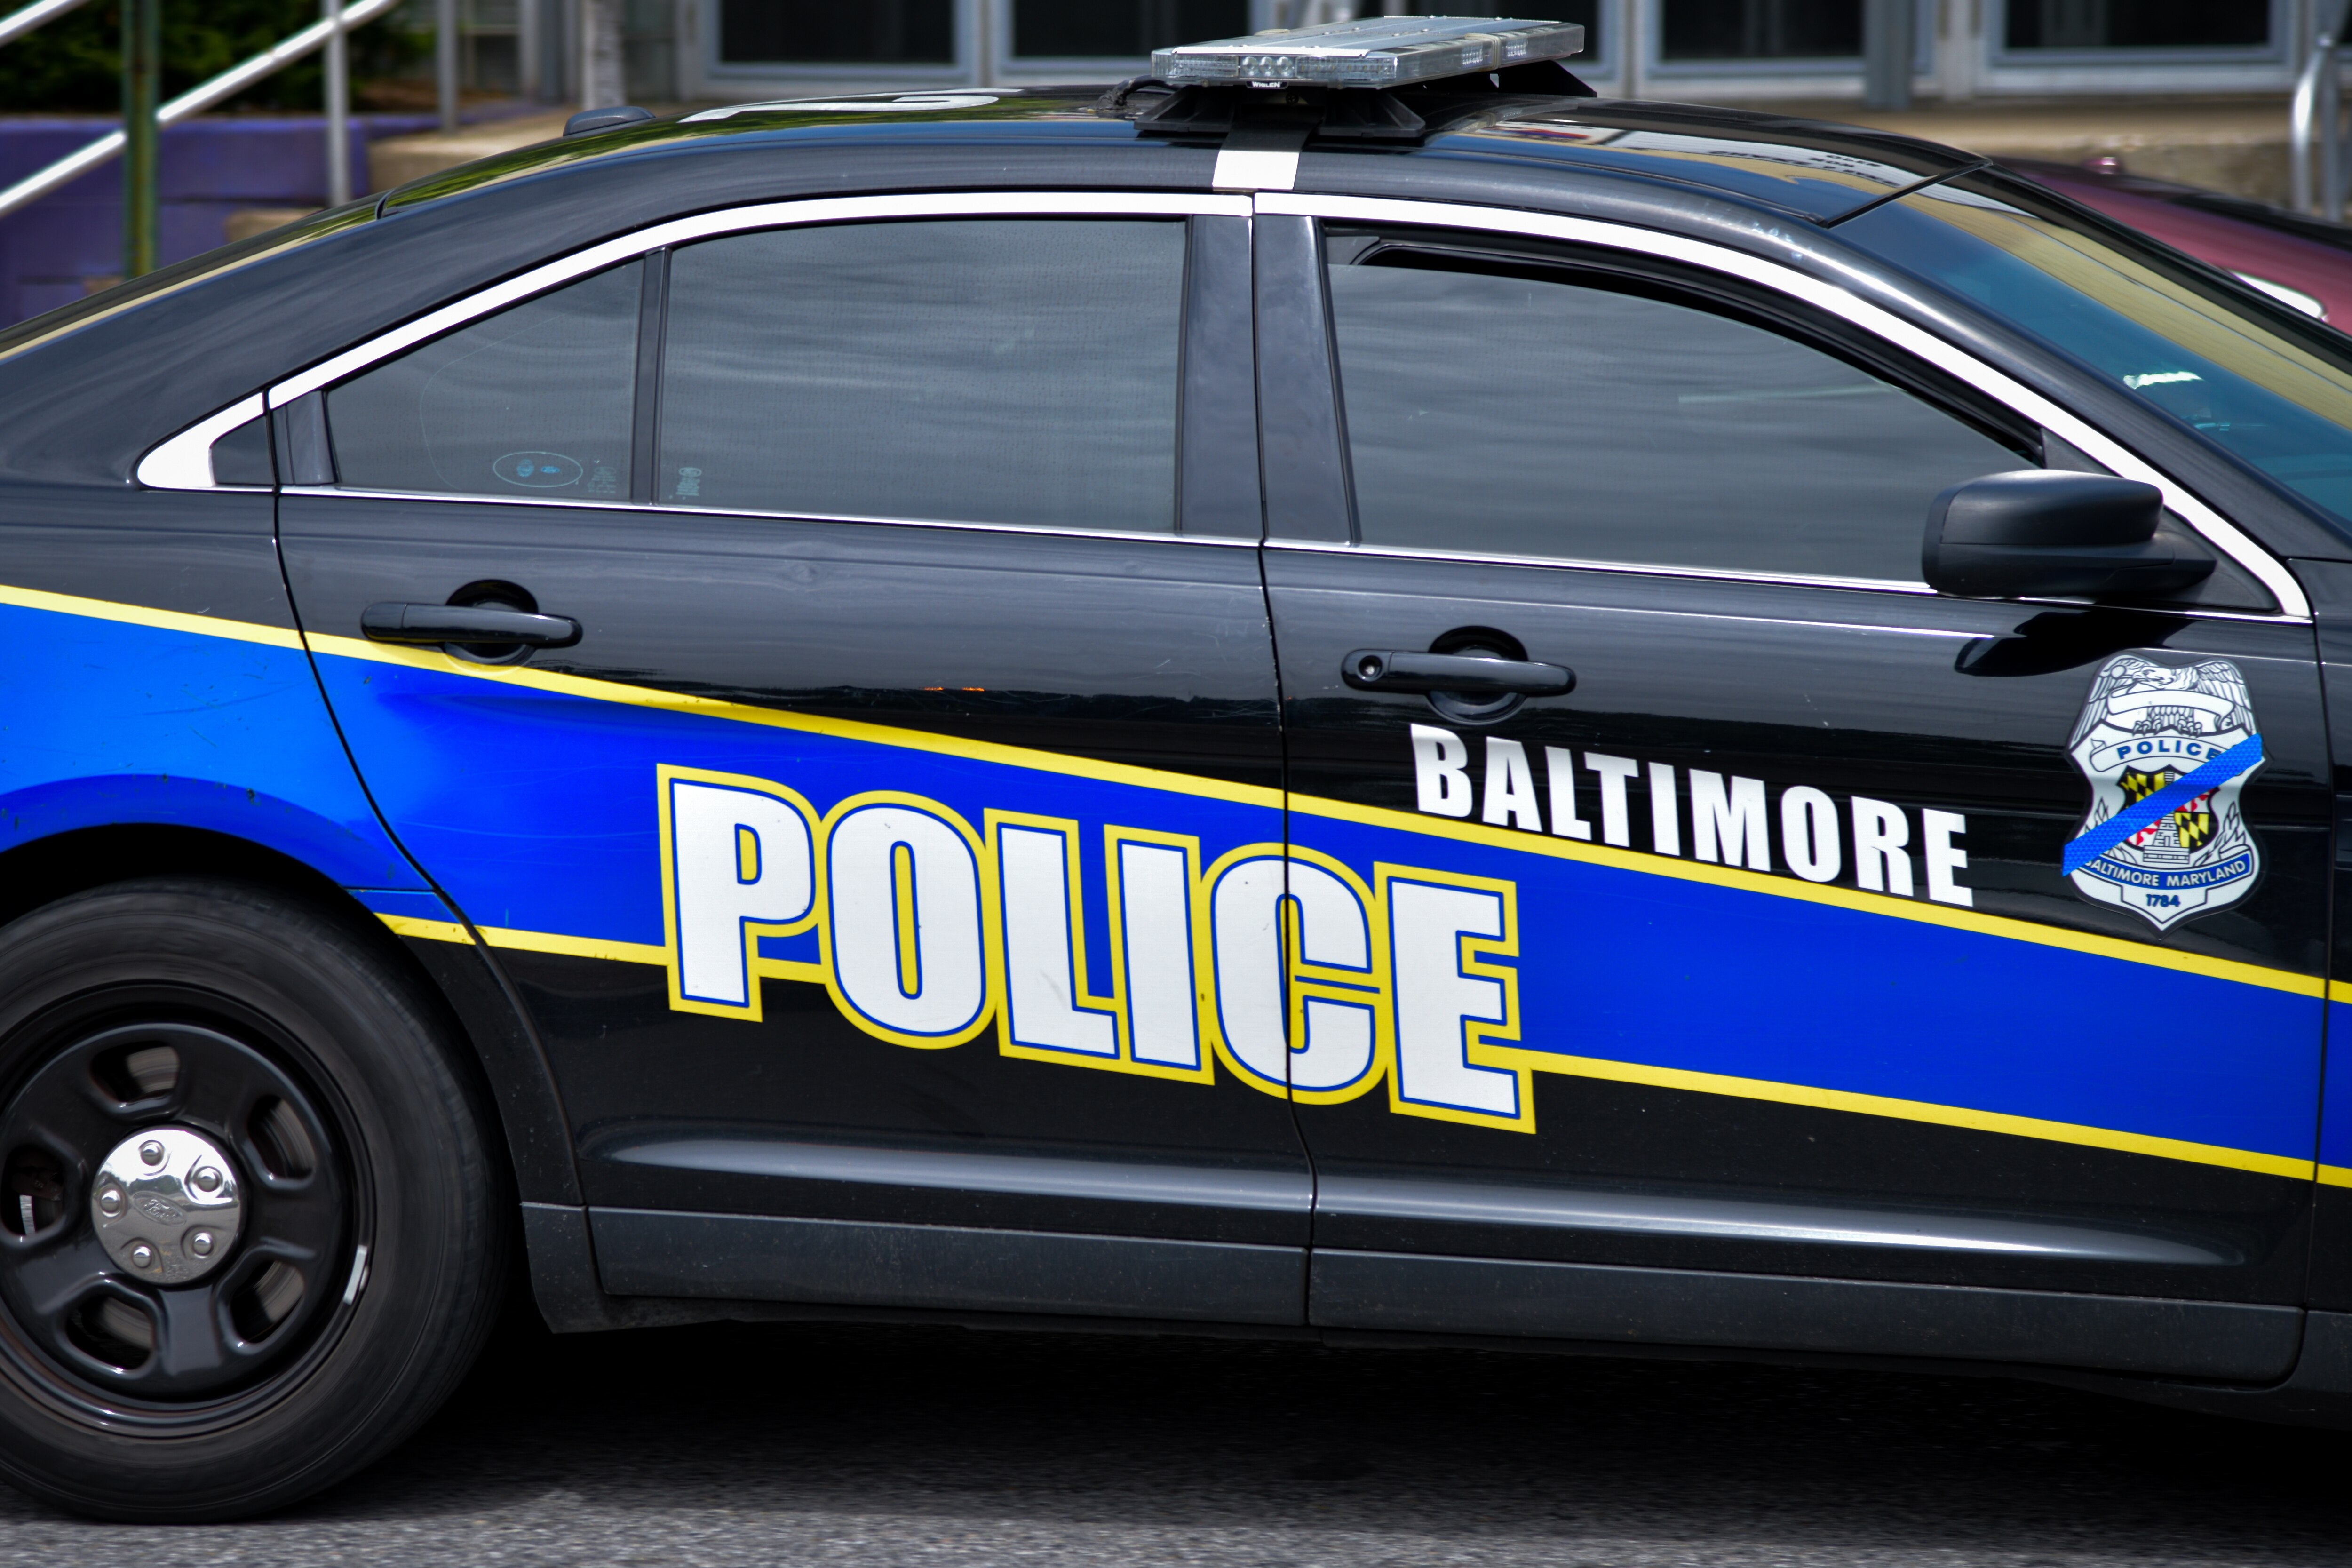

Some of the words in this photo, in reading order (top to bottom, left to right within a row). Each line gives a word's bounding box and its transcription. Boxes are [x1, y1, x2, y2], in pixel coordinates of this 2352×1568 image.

[2117, 740, 2222, 761] POLICE
[1411, 723, 1974, 907] BALTIMORE
[2166, 860, 2247, 887] MARYLAND
[2146, 893, 2181, 907] 1784
[663, 772, 1528, 1127] POLICE
